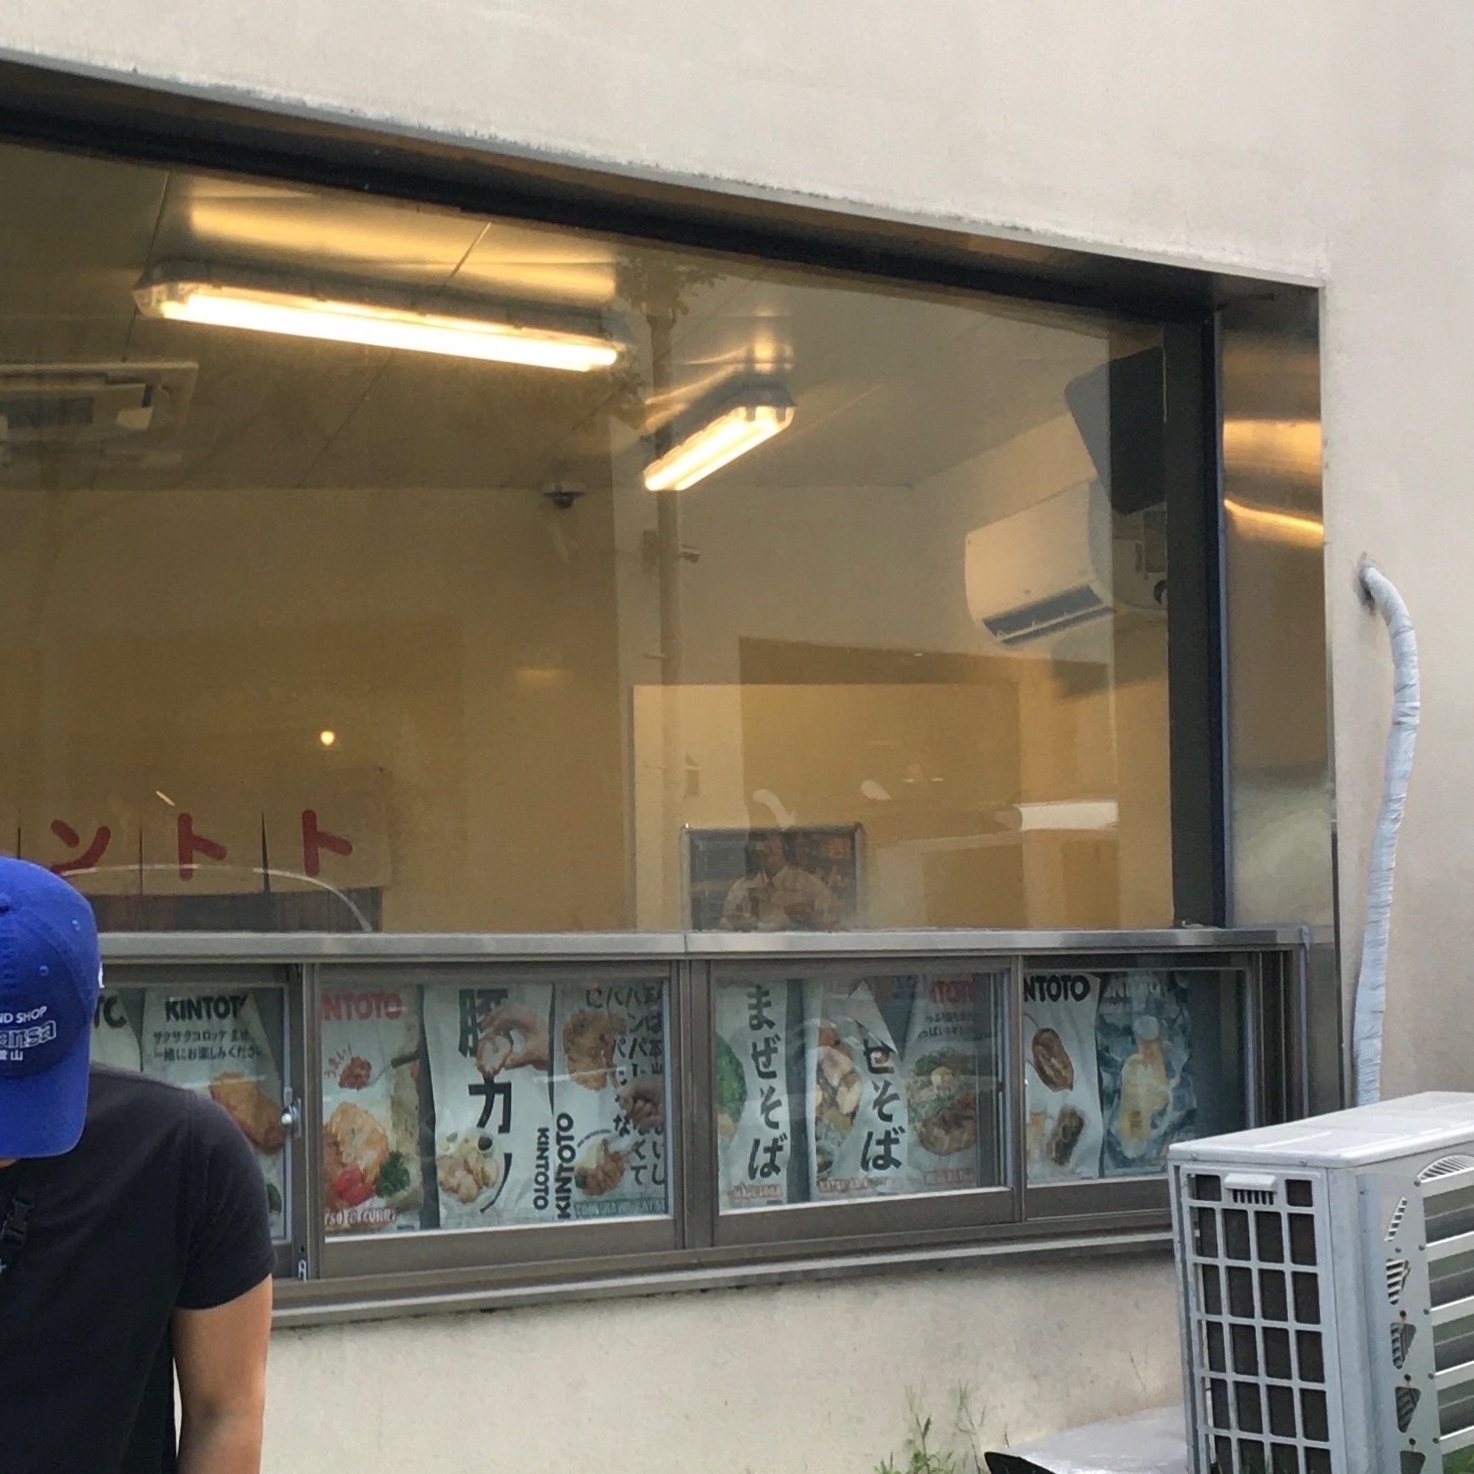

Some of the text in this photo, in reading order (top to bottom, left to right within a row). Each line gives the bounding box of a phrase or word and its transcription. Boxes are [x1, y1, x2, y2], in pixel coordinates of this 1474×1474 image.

[16, 1005, 47, 1023] SHOP
[165, 995, 247, 1022] KINTOT
[747, 984, 787, 1180] まぜそば
[533, 1126, 550, 1211] KINTOTO
[555, 1112, 576, 1220] KINTOTO
